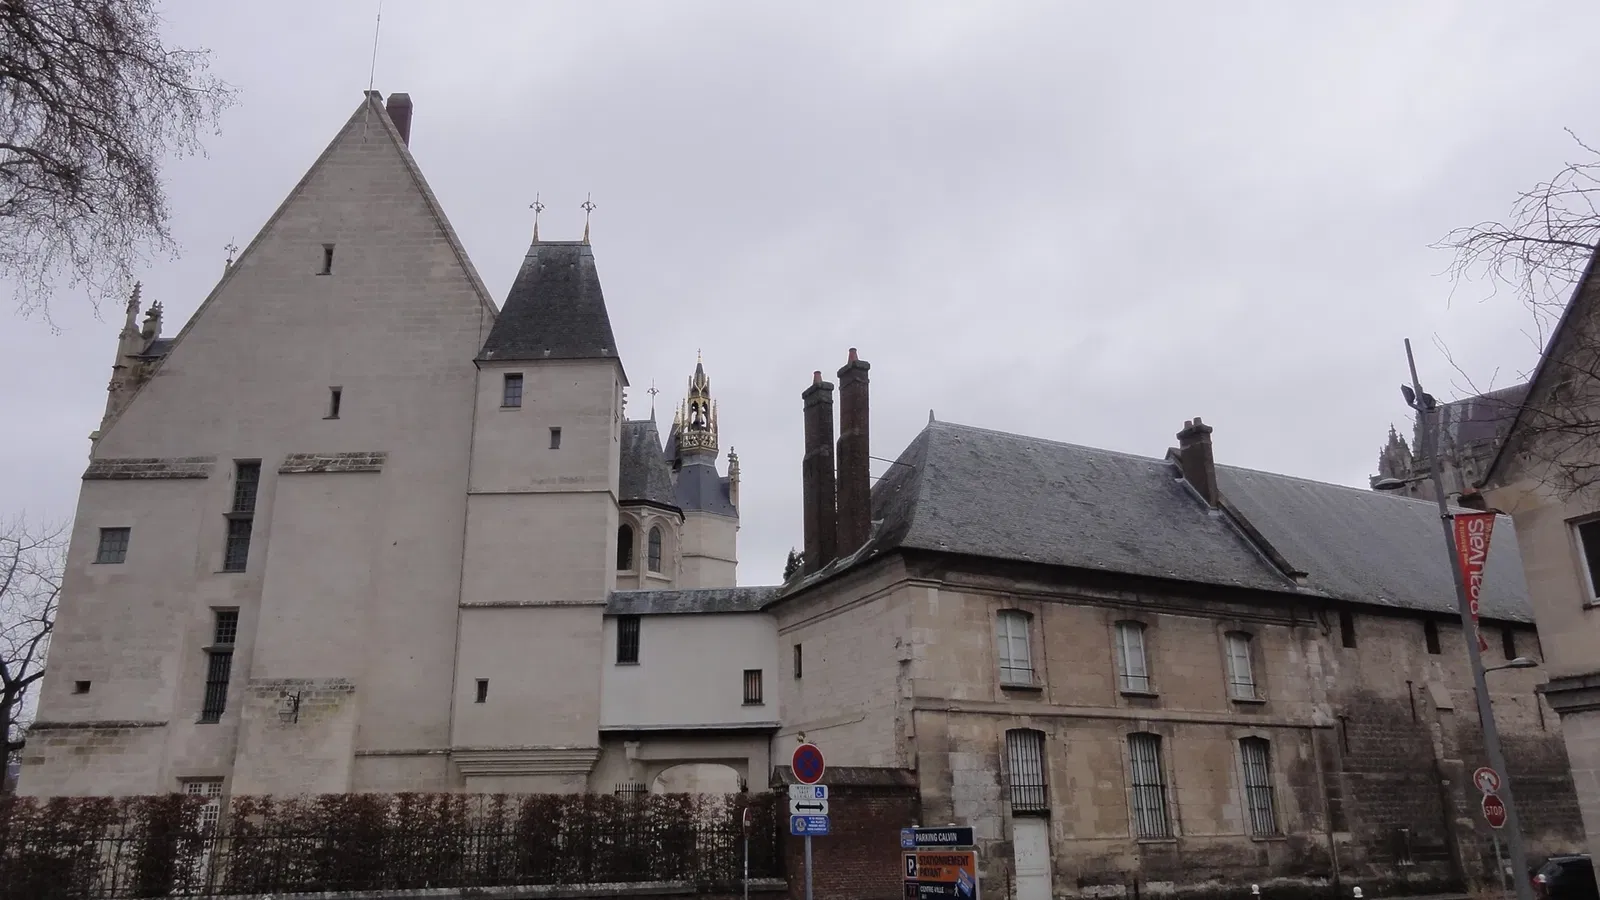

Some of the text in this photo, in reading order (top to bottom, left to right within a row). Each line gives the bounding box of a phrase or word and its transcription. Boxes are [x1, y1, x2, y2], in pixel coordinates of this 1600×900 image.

[1485, 805, 1503, 816] STOP
[915, 833, 938, 842] PARKING
[938, 832, 958, 842] CALVIN
[919, 855, 969, 866] STATIONNEMENT
[920, 867, 942, 877] PAYANT
